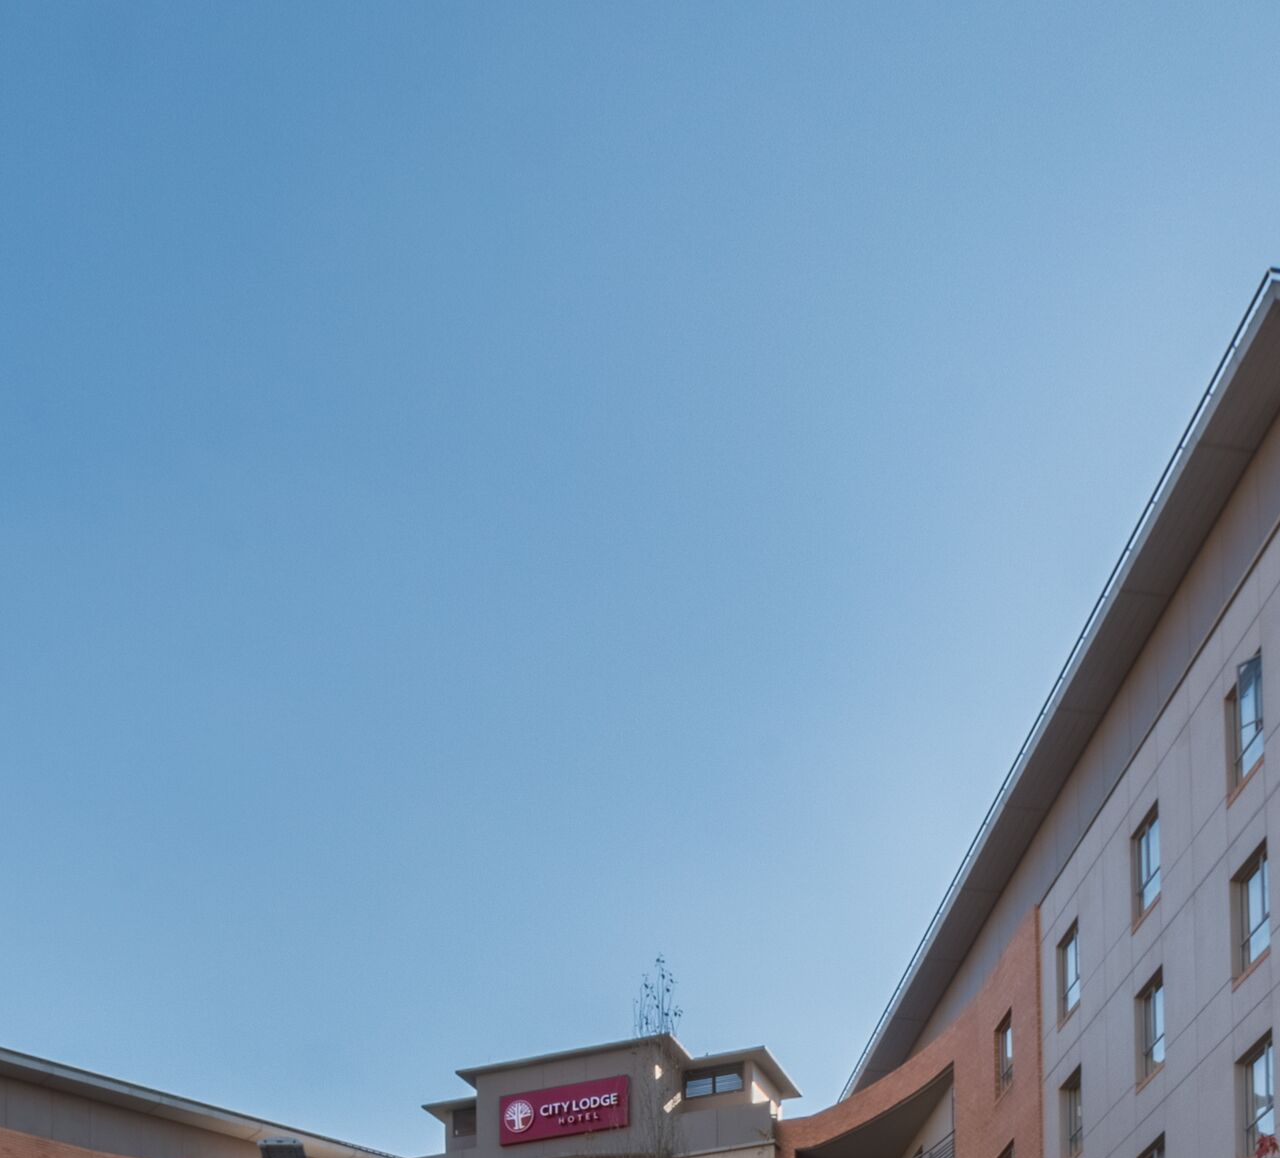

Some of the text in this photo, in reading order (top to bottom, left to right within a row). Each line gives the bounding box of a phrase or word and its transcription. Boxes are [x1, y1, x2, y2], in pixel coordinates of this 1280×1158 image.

[540, 1093, 618, 1117] CITY LODGE
[558, 1111, 599, 1124] HOTEL
